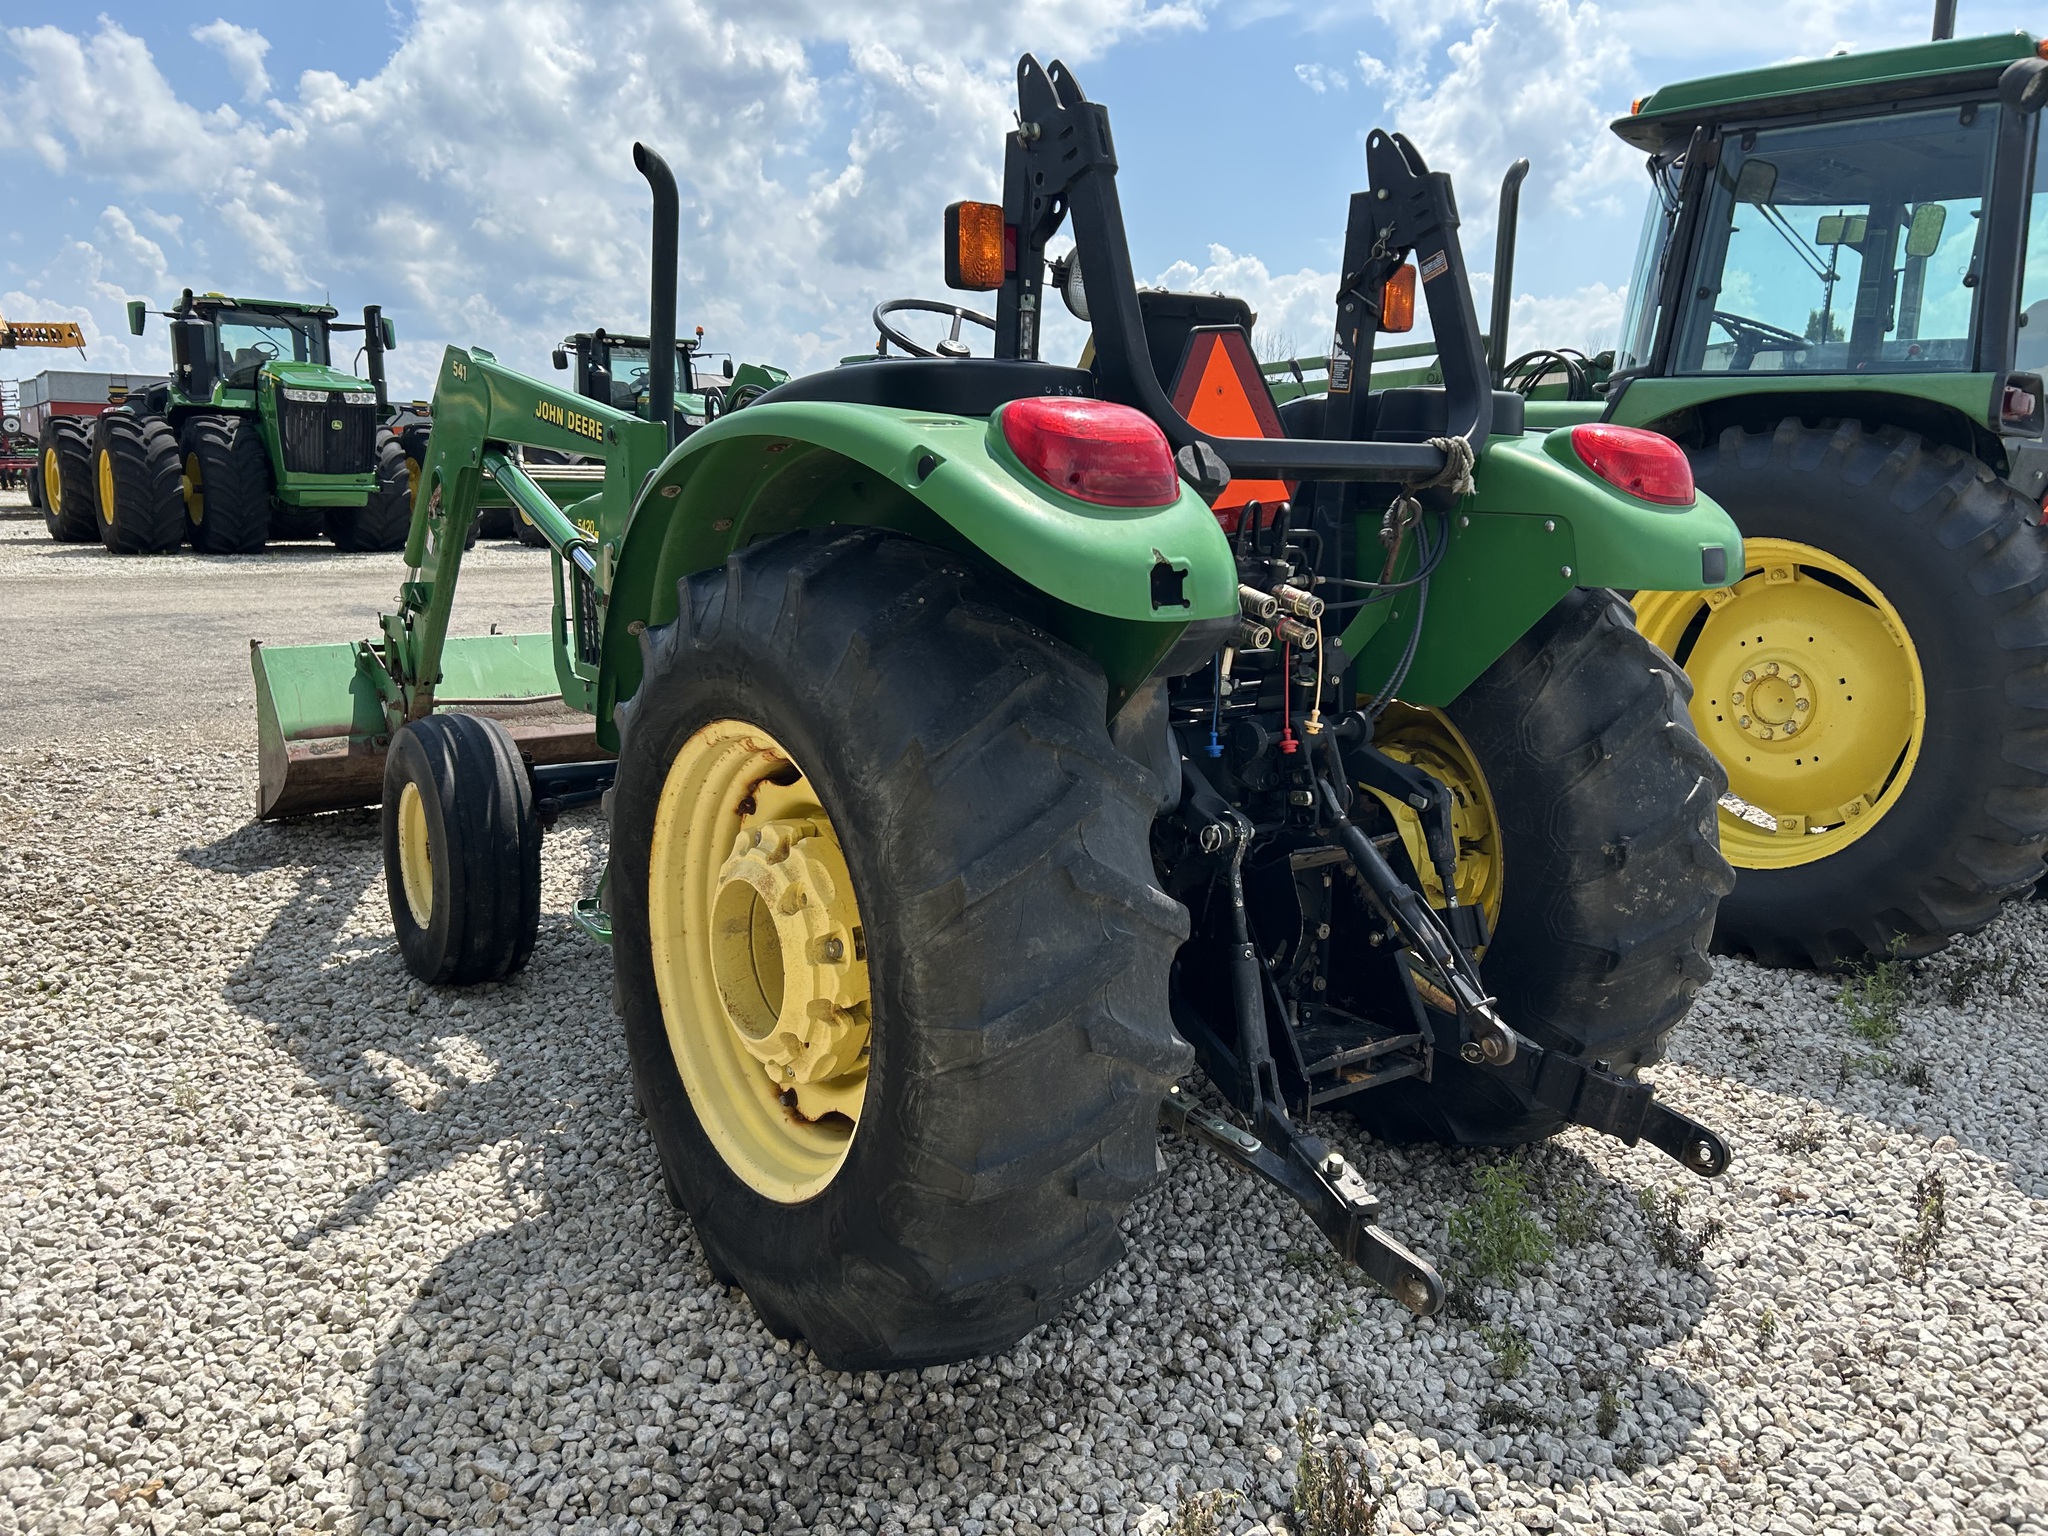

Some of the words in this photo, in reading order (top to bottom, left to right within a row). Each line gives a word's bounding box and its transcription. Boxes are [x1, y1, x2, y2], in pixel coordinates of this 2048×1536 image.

[453, 360, 467, 382] 541
[535, 400, 564, 428] JOHN
[567, 410, 603, 442] DEERE
[577, 518, 595, 534] 5420
